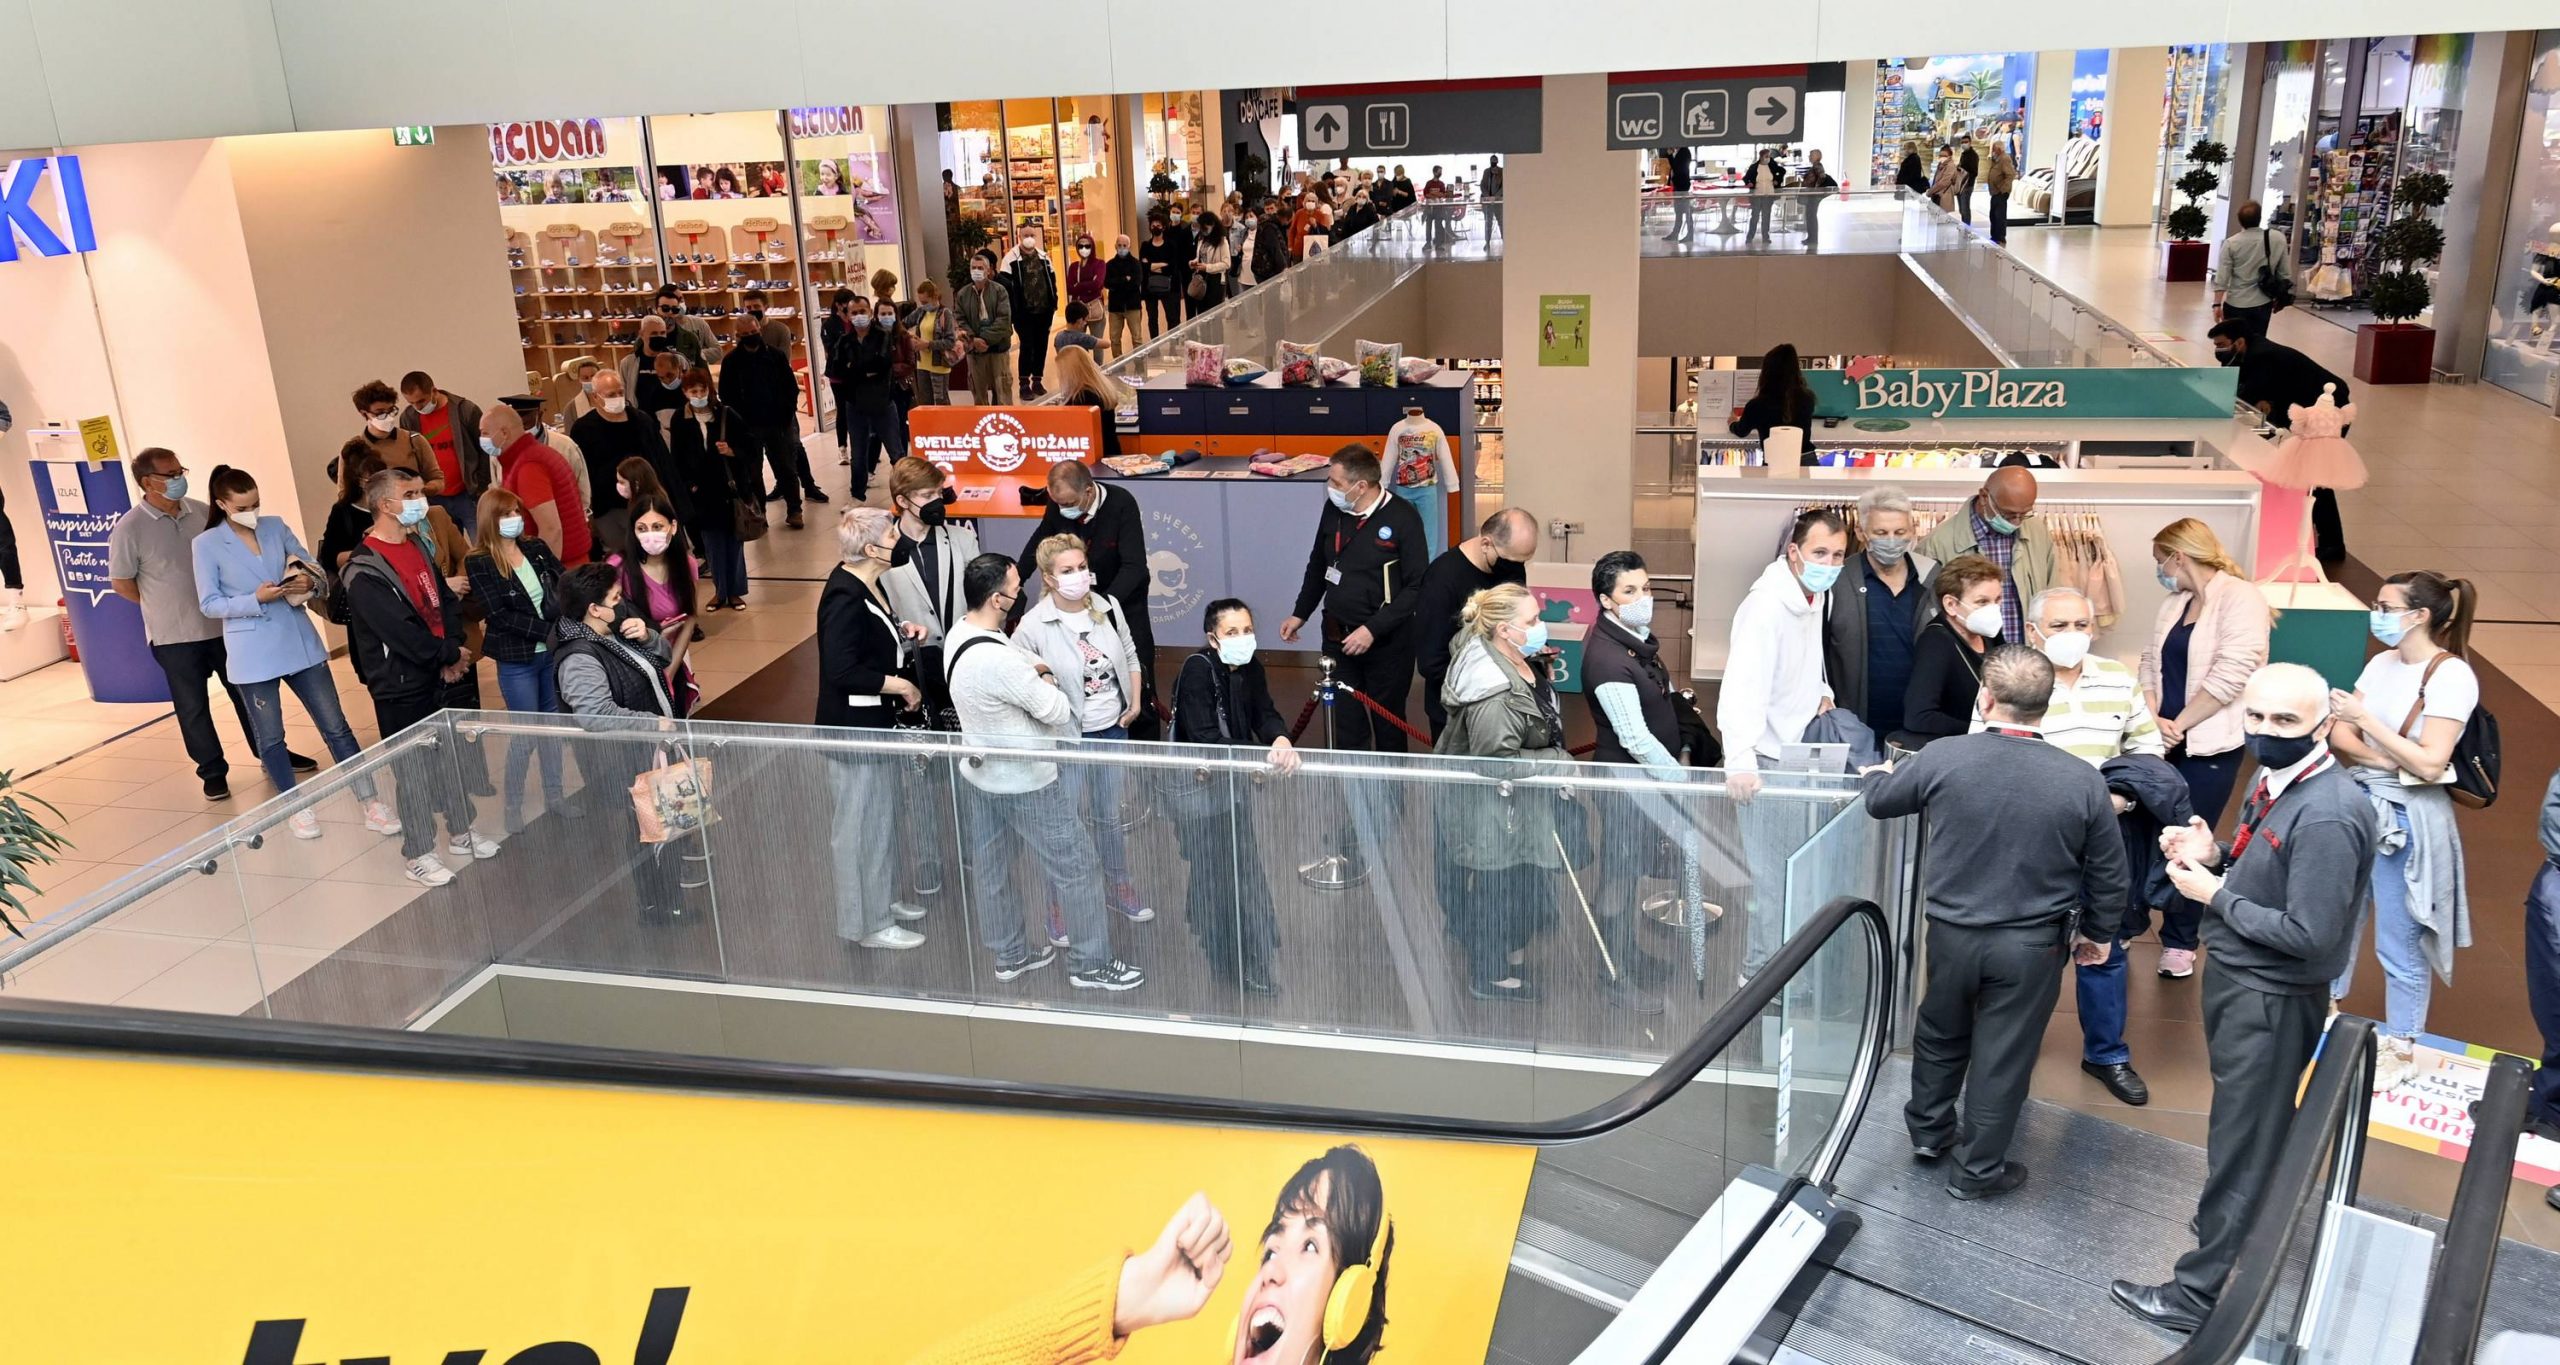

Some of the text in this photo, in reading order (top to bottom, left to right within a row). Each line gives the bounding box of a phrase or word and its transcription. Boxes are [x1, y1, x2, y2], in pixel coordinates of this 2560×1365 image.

[1621, 119, 1658, 136] WC
[489, 118, 606, 164] iciban
[1856, 369, 2067, 419] BabyPlaza
[1021, 433, 1091, 450] PIDŽAME
[57, 487, 79, 498] IZLAZ
[47, 511, 122, 542] inspirišit
[1152, 511, 1205, 550] SHEEPY
[62, 548, 98, 567] Pratite
[2430, 1075, 2483, 1096] 2 m
